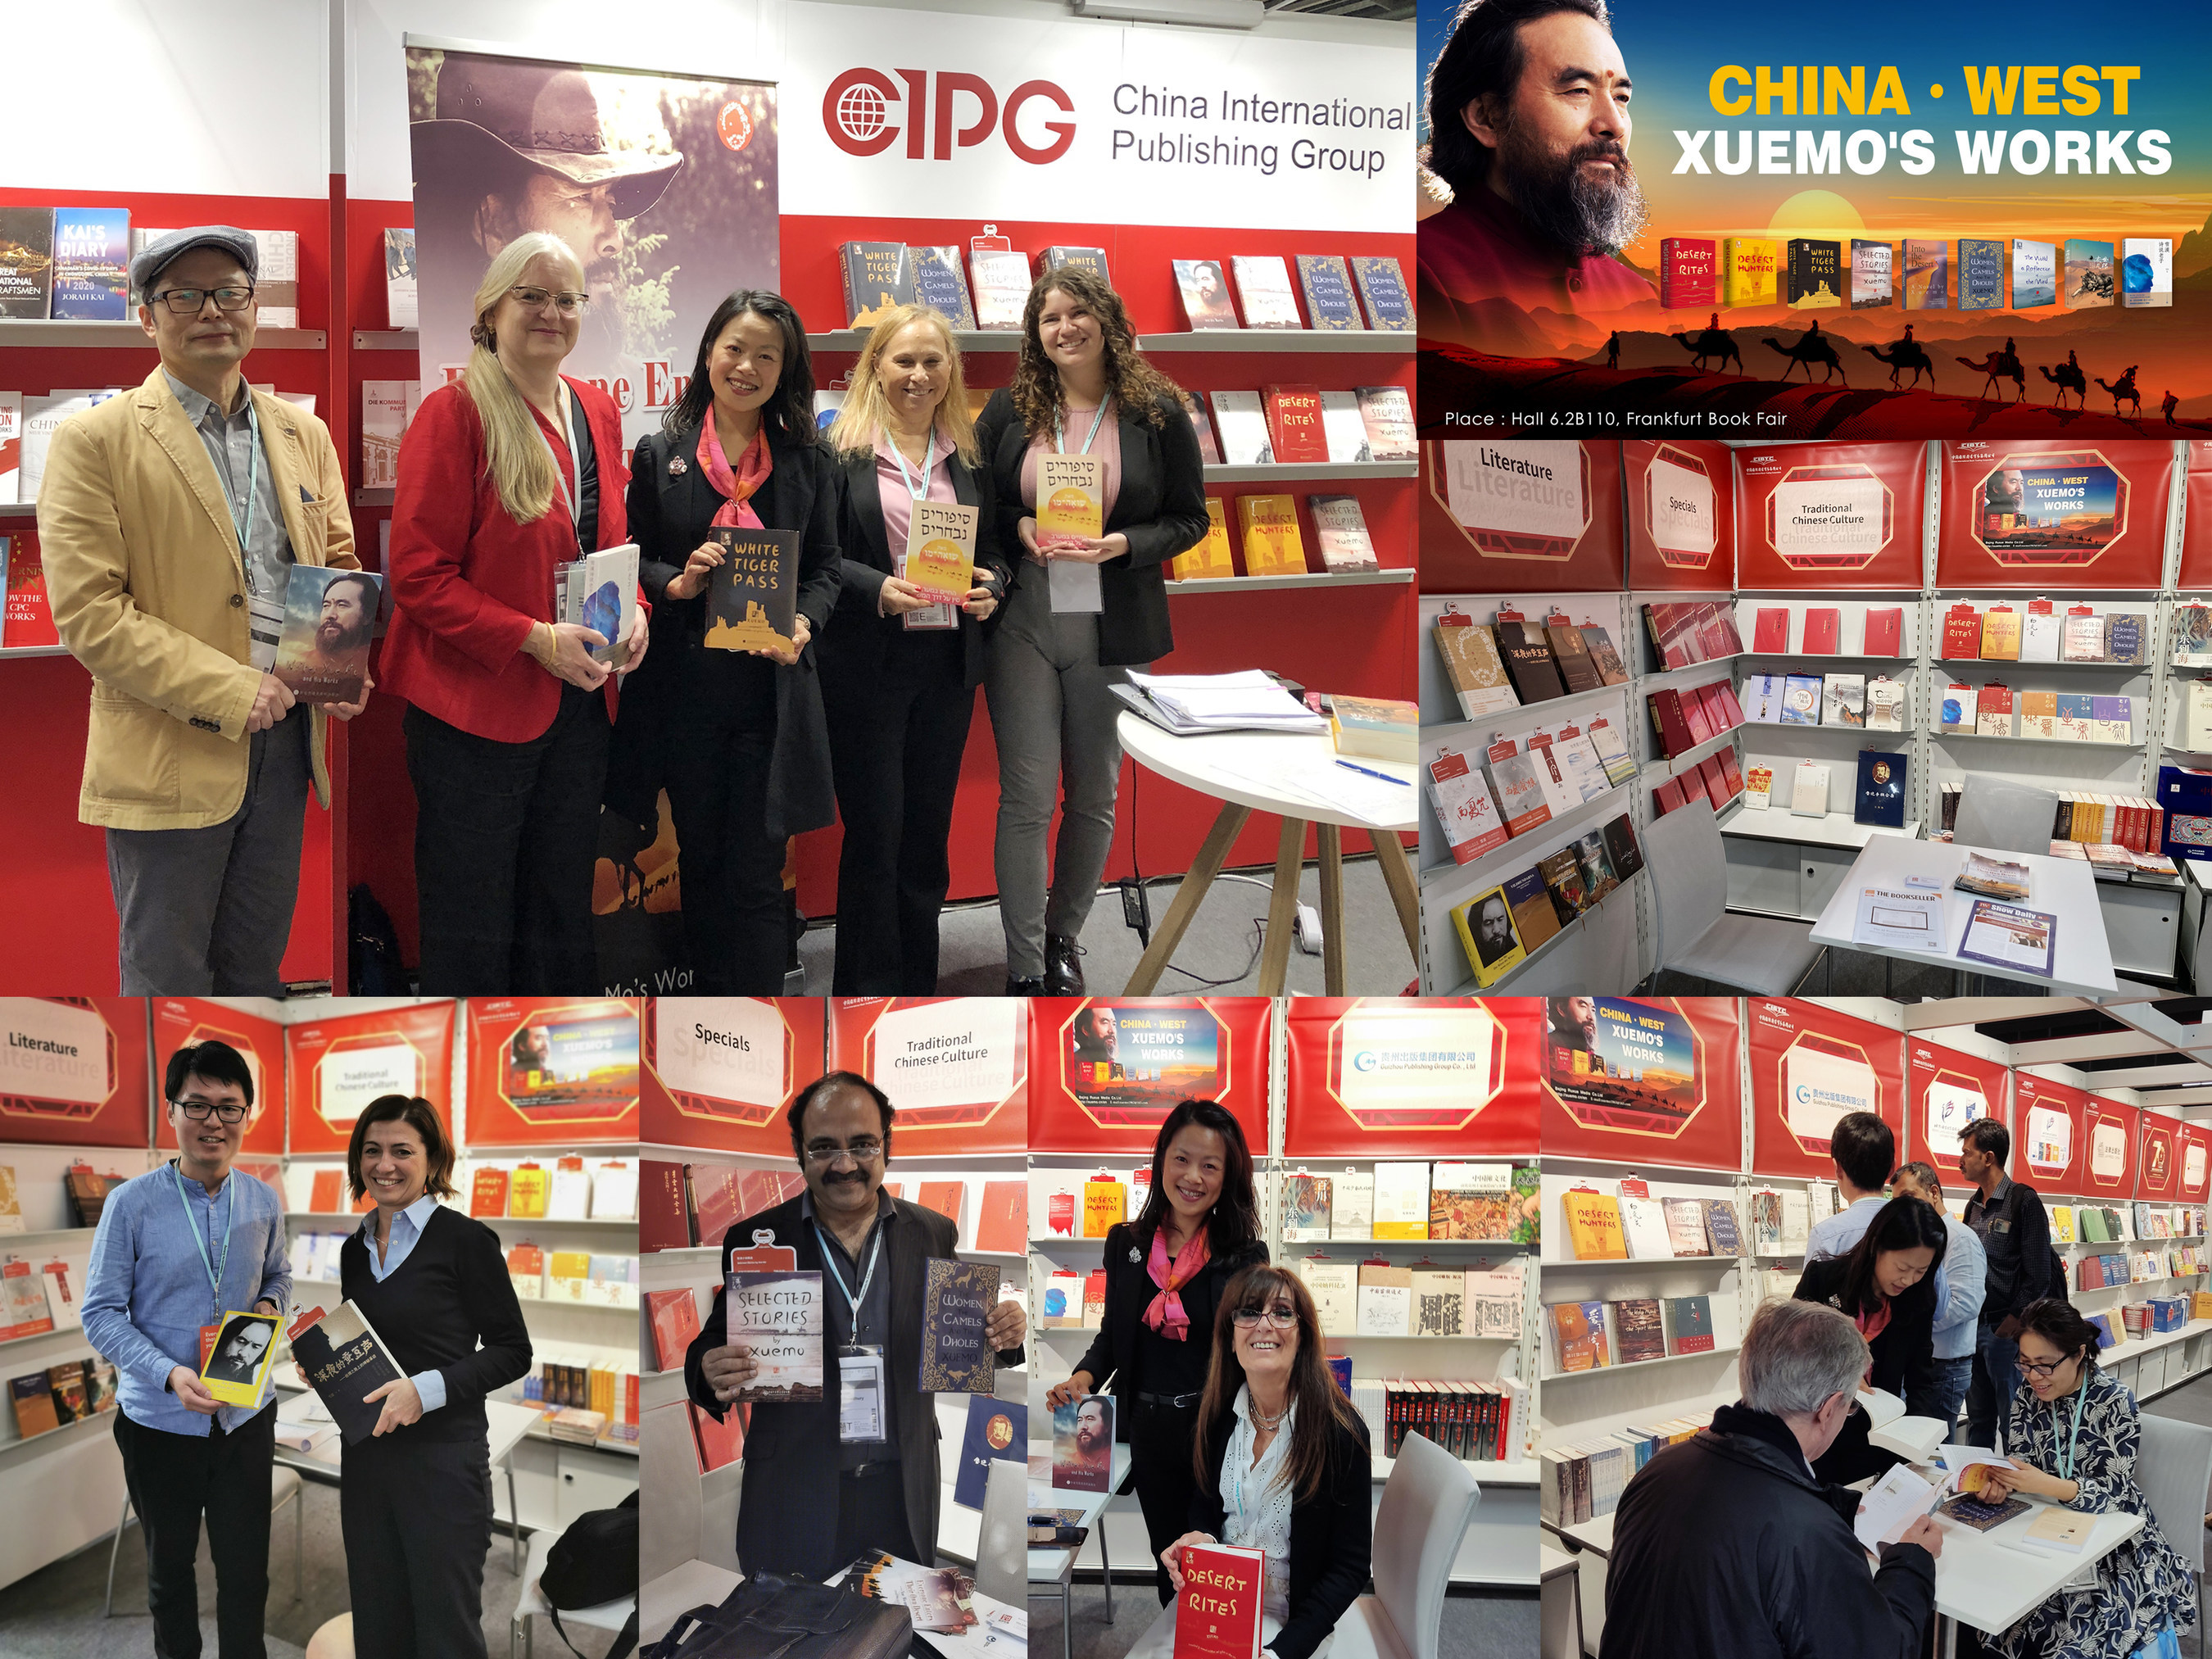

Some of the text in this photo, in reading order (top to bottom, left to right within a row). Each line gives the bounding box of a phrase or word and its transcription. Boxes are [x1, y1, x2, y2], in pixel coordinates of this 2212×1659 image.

[1113, 84, 1412, 131] China International
[823, 66, 1077, 165] CIPG
[1113, 129, 1386, 179] Publishing Group
[63, 224, 106, 241] KAI'S
[60, 242, 109, 257] DIARY
[1676, 250, 1711, 260] DESERT
[1859, 251, 1890, 259] SELECTED
[1911, 245, 1925, 253] Into
[864, 252, 896, 261] WHITE
[1067, 257, 1097, 266] WHITE
[1738, 255, 1774, 264] DESERT
[1811, 257, 1834, 265] TIGER
[1679, 264, 1708, 274] RITES
[1738, 264, 1774, 273] HUNTERS
[1861, 261, 1888, 270] STORIES
[73, 282, 95, 291] 2020
[1278, 397, 1316, 408] DESERT
[1367, 397, 1404, 408] SELECTED
[1284, 413, 1315, 425] RITES
[1371, 408, 1407, 418] STORIES
[1046, 461, 1095, 473] סיפורים
[1480, 447, 1552, 481] Literature
[1048, 475, 1093, 487] נבחרים
[1457, 460, 1575, 510] Literature
[2027, 477, 2088, 487] CHINA WEST
[2037, 487, 2085, 498] XUEMO'S
[1320, 505, 1358, 515] SELECTED
[1670, 496, 1697, 514] Specials
[1802, 503, 1852, 514] Traditional
[2044, 501, 2084, 510] WORKS
[921, 509, 971, 525] סיפורים
[1325, 516, 1358, 526] STORIES
[1660, 501, 1710, 532] Specials
[1792, 515, 1864, 525] Chinese Culture
[922, 524, 968, 540] נבחרים
[1255, 525, 1294, 534] HUNTERS
[1781, 532, 1877, 545] Chinese Culture
[734, 542, 779, 556] WHITE
[734, 558, 779, 573] TIGER
[732, 573, 779, 590] PASS
[22, 594, 42, 603] THE
[10, 604, 29, 612] CPC
[919, 612, 927, 621] E
[1948, 619, 1976, 628] DESERT
[1949, 629, 1972, 637] RITES
[1876, 890, 1935, 903] THE BOOKSELLER
[1991, 904, 2037, 919] Show Daily
[1599, 1006, 1665, 1031] CHINA WEST
[1120, 1020, 1186, 1030] CHINA WEST
[553, 1030, 581, 1041] CHINA
[695, 1022, 750, 1052] Specials
[1131, 1033, 1185, 1045] XUEMO'S
[1611, 1024, 1664, 1047] XUEMO'S
[9, 1032, 78, 1057] Literature
[563, 1039, 612, 1053] XUEMO'S
[907, 1031, 972, 1053] Traditional
[895, 1047, 988, 1069] Chinese Culture
[1141, 1048, 1185, 1060] WORKS
[1381, 1051, 1475, 1062] 贵州出版集团有限公司
[1622, 1044, 1665, 1064] WORKS
[1404, 1063, 1433, 1071] Publishing
[1435, 1063, 1451, 1071] Group
[344, 1069, 388, 1081] Traditional
[335, 1079, 399, 1092] Chinese Culture
[1812, 1088, 1867, 1108] 贵州出版集团有限公司
[1812, 1098, 1855, 1113] Guizhou Publishing Group
[1086, 1195, 1118, 1204] DESERT
[1086, 1203, 1117, 1213] HUNTERS
[1578, 1208, 1616, 1219] DESERT
[1670, 1206, 1699, 1214] SELECTED
[1287, 1207, 1299, 1240] 东到海
[1579, 1218, 1616, 1229] HUNTERS
[1673, 1215, 1699, 1223] STORIES
[738, 1292, 812, 1308] SELECTED
[740, 1311, 807, 1326] STORIES
[942, 1312, 981, 1326] CAMELS
[1634, 1325, 1647, 1334] Spirit
[773, 1336, 781, 1344] by
[942, 1335, 978, 1348] DHOLES
[750, 1346, 805, 1358] xuemo
[942, 1352, 977, 1362] XUEMO
[314, 1339, 373, 1383] 深夜的蚕豆声
[845, 1422, 852, 1431] T
[1187, 1568, 1247, 1591] DESERT
[917, 1580, 928, 1604] Everyone
[905, 1581, 913, 1594] Their
[913, 1605, 922, 1621] Desert
[1190, 1593, 1237, 1616] RITES
